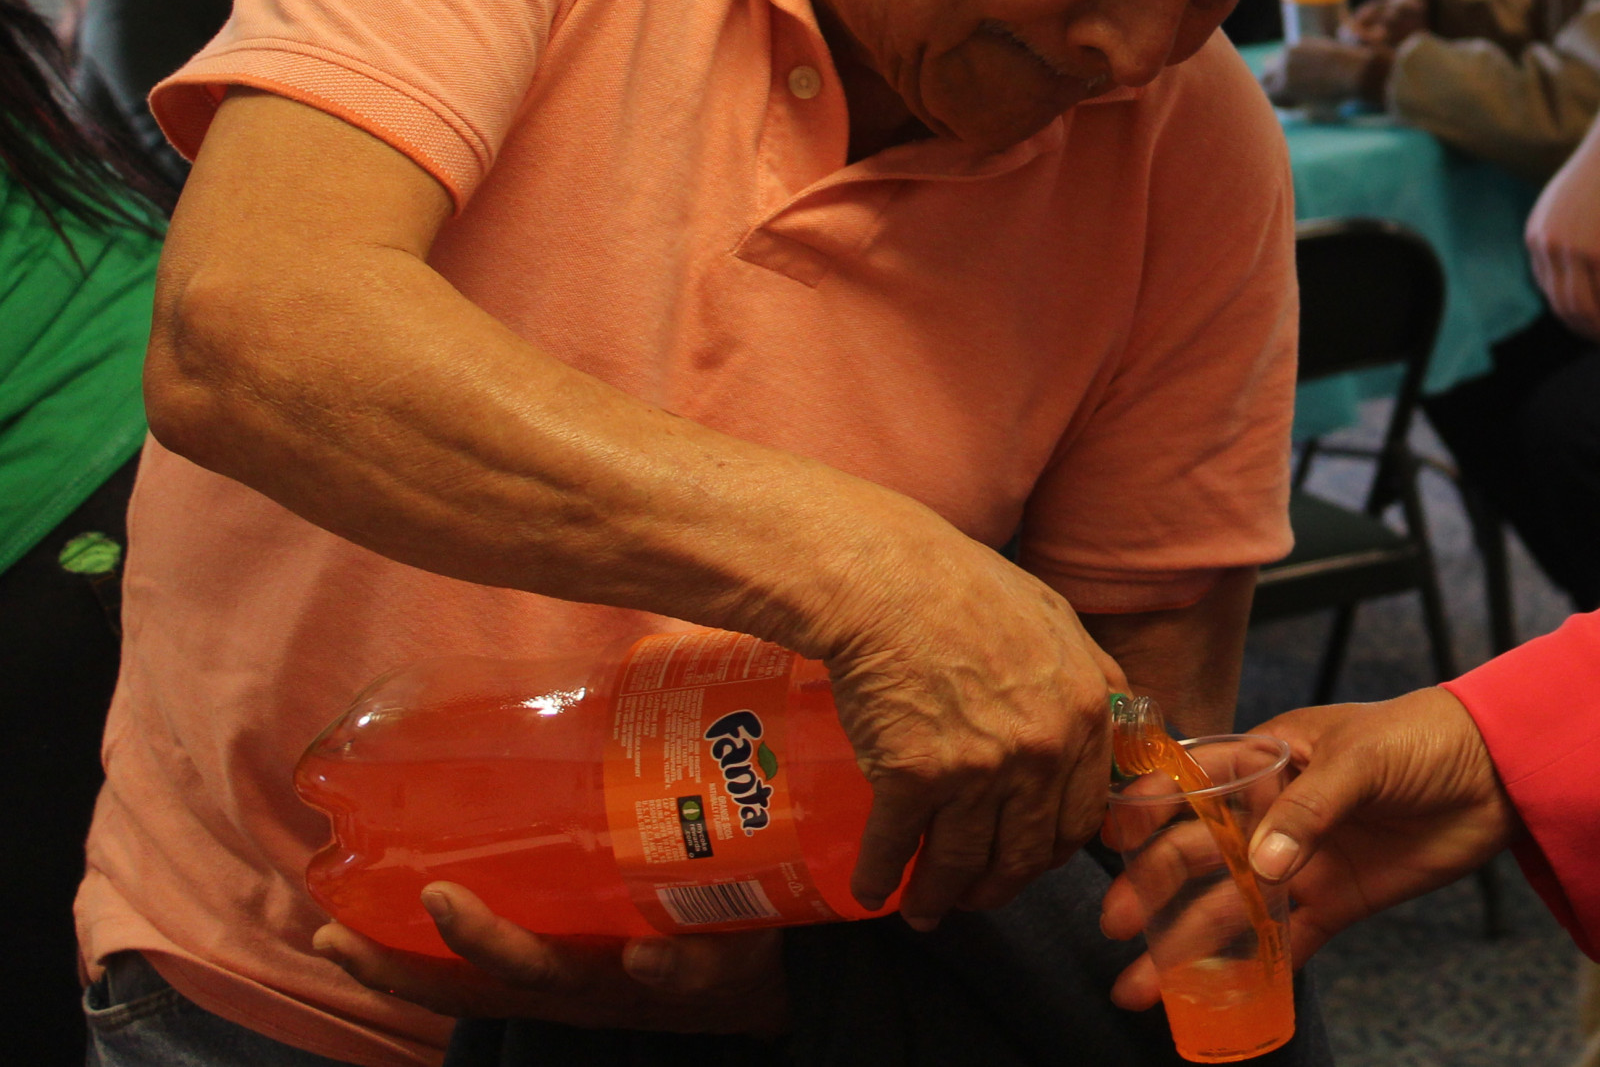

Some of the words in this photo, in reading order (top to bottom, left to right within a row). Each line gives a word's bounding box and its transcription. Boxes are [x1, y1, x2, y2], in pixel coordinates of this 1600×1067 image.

[704, 709, 774, 830] Fanta
[717, 796, 730, 821] ORANGE
[689, 824, 700, 851] rewards
[697, 823, 707, 851] mycoke
